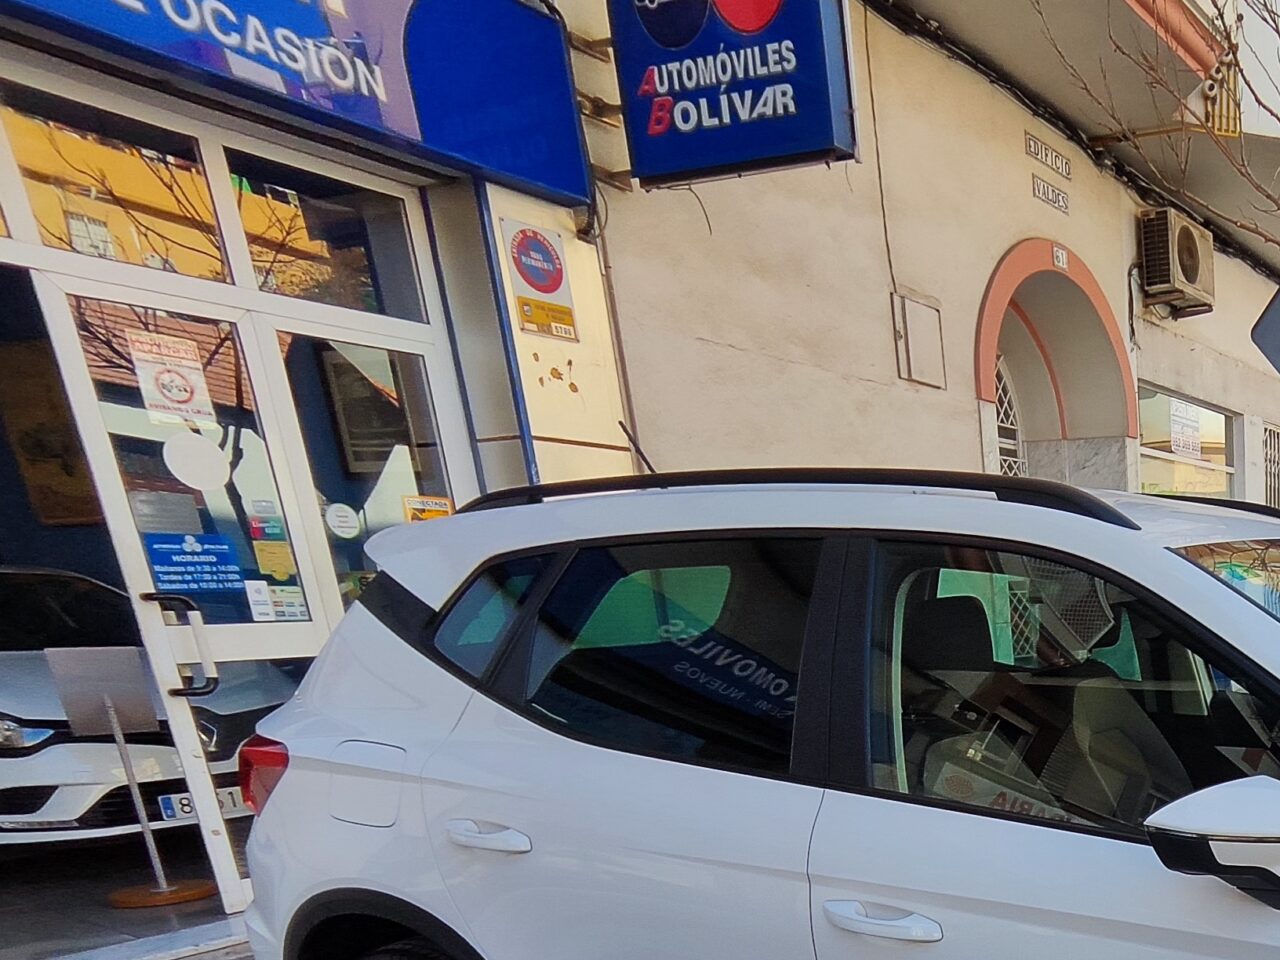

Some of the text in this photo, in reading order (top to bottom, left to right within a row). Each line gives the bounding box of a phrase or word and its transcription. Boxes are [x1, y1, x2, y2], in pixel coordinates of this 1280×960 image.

[637, 39, 797, 97] AUTOMÓVILES
[647, 82, 798, 136] BOLÍVAR
[1028, 137, 1071, 177] EDIFICIO
[1036, 179, 1069, 210] VALDES
[1054, 248, 1066, 267] 61
